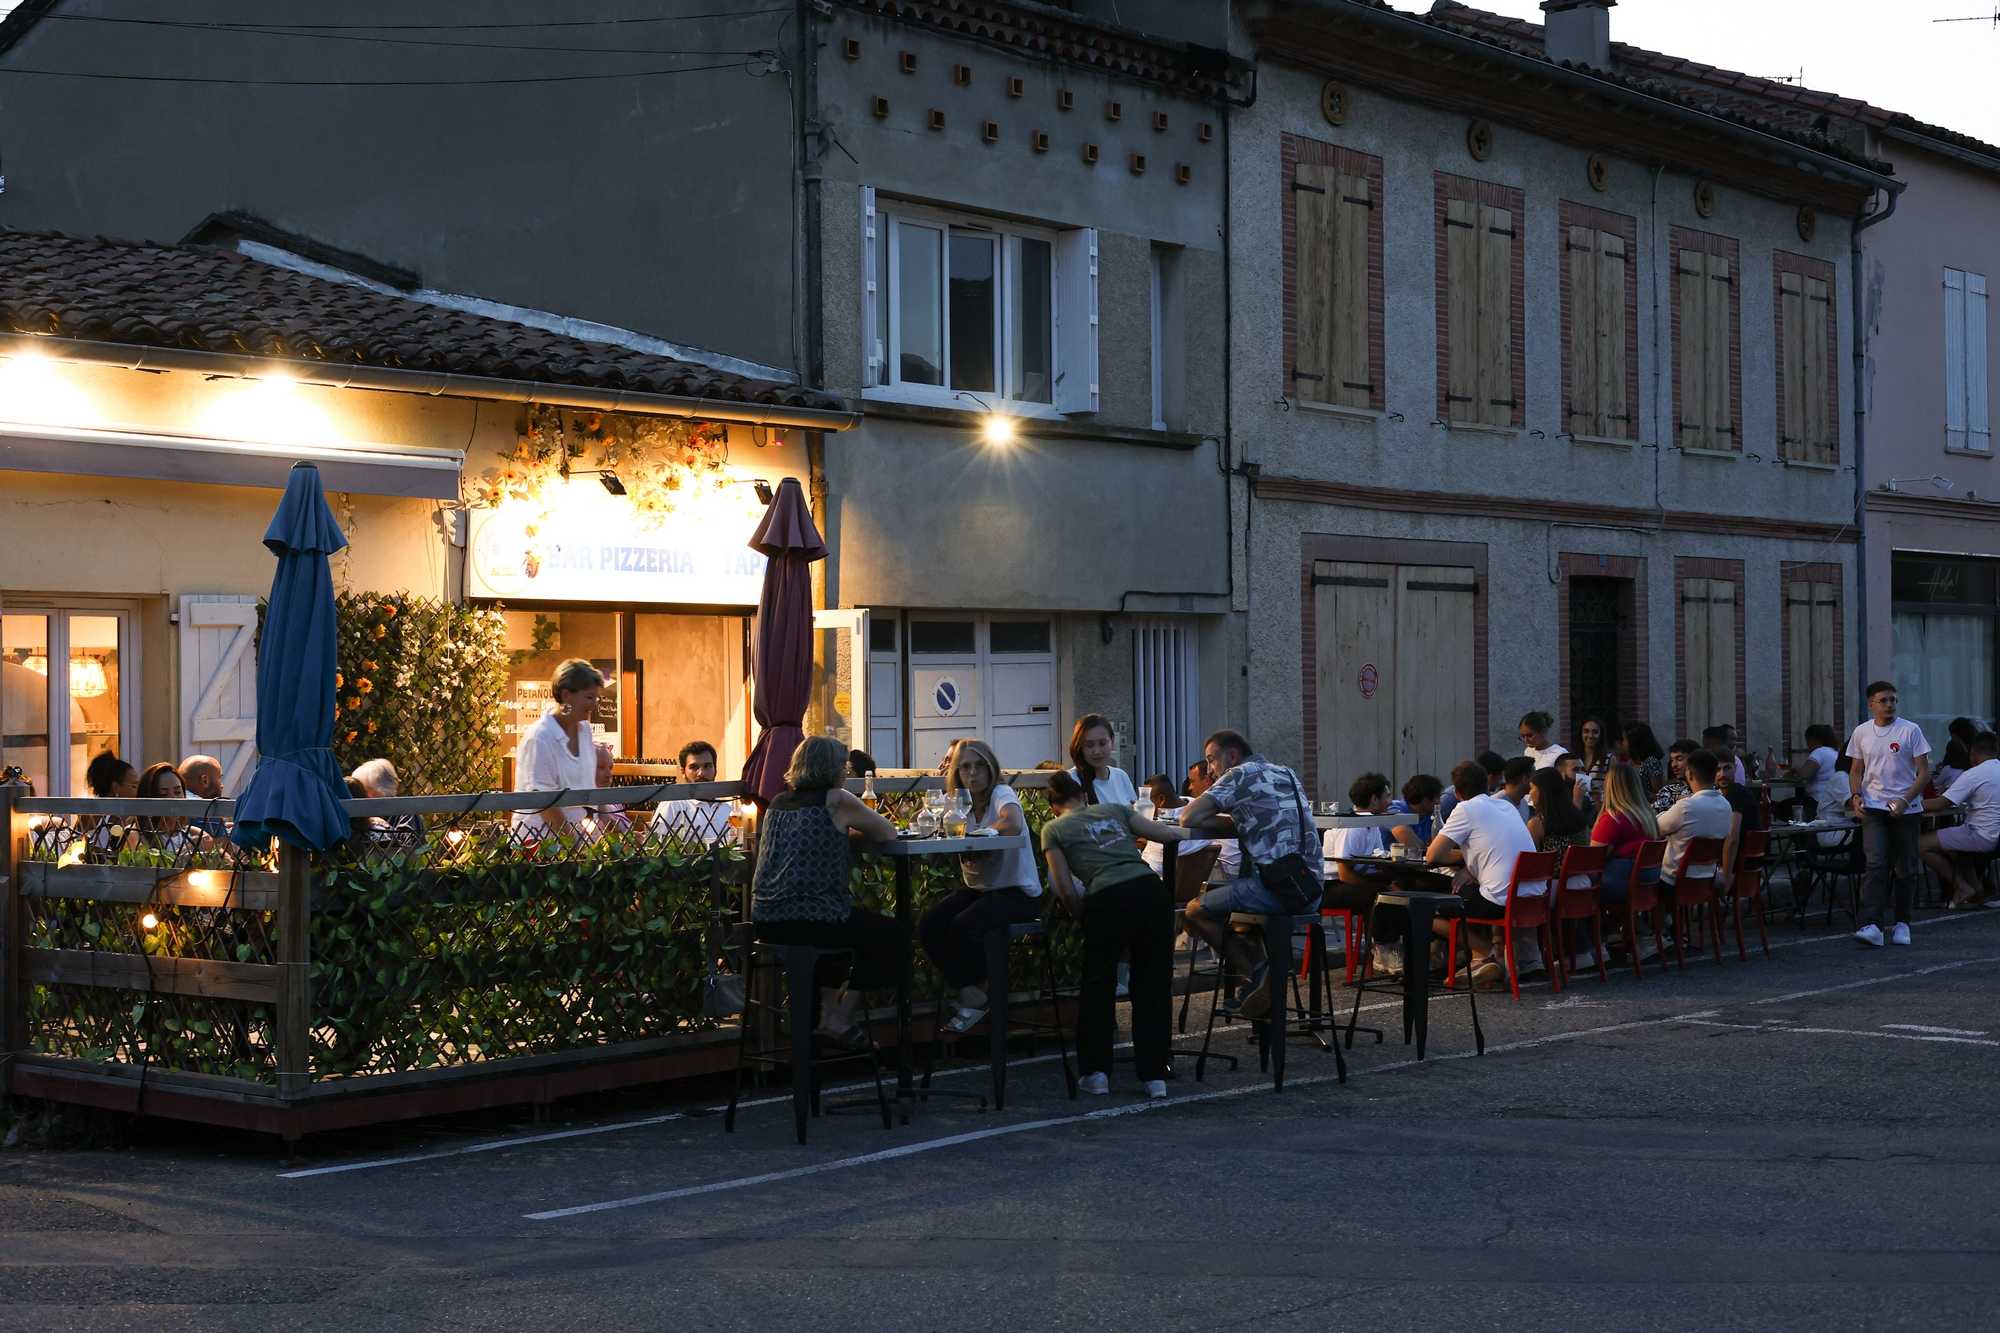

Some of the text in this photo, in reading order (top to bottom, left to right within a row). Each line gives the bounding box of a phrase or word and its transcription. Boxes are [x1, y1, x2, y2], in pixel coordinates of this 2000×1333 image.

[547, 544, 594, 570] BAR
[599, 546, 695, 574] PIZZERIA
[517, 688, 555, 700] PETANQU
[504, 723, 529, 734] PLAC
